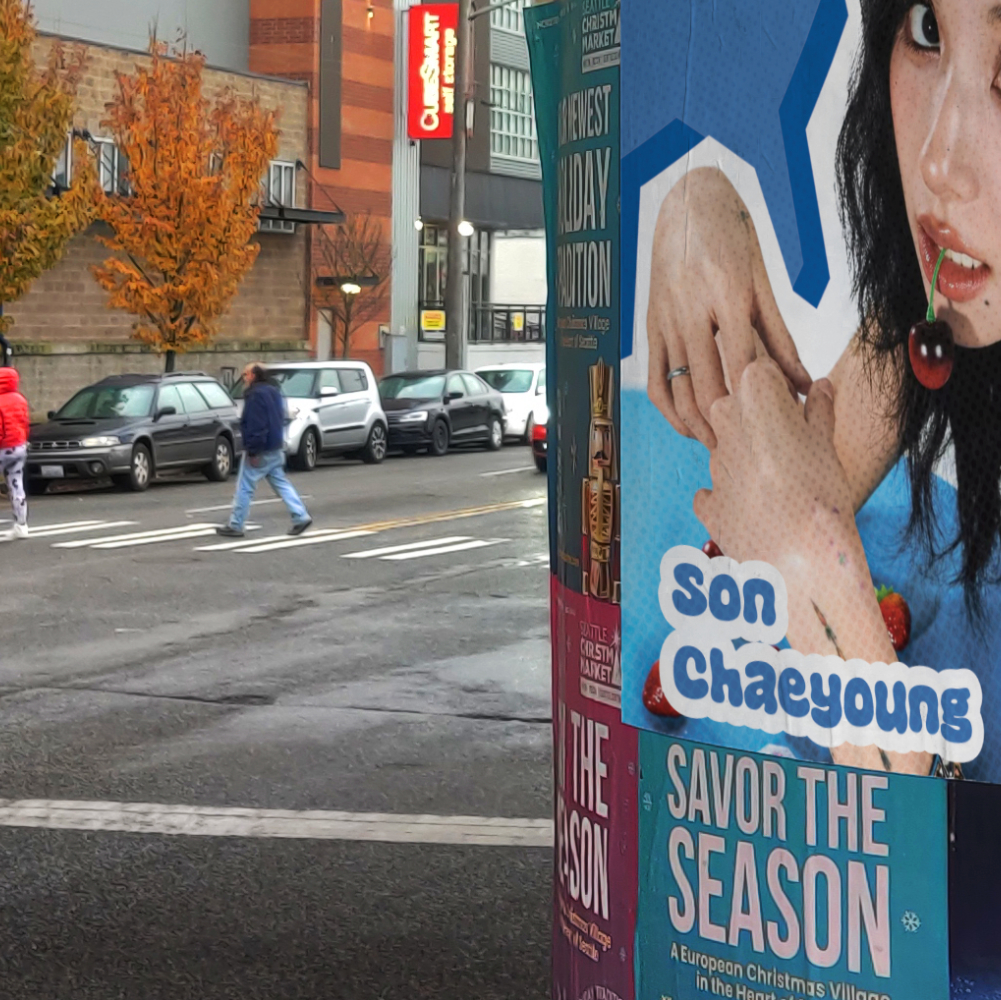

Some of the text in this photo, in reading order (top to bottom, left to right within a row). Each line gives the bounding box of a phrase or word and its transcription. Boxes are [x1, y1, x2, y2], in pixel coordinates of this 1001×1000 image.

[582, 28, 615, 54] MARKET
[567, 84, 612, 143] NEWEST
[672, 645, 973, 744] Chaeyoung
[570, 709, 610, 820] THE
[666, 743, 787, 840] SAVOR
[797, 767, 890, 858] THE
[556, 784, 610, 921] EASON
[667, 823, 892, 978] SEASON
[670, 942, 679, 960] A
[681, 945, 743, 979] European
[746, 963, 826, 998] Christmas
[696, 971, 708, 992] in
[711, 976, 733, 998] the
